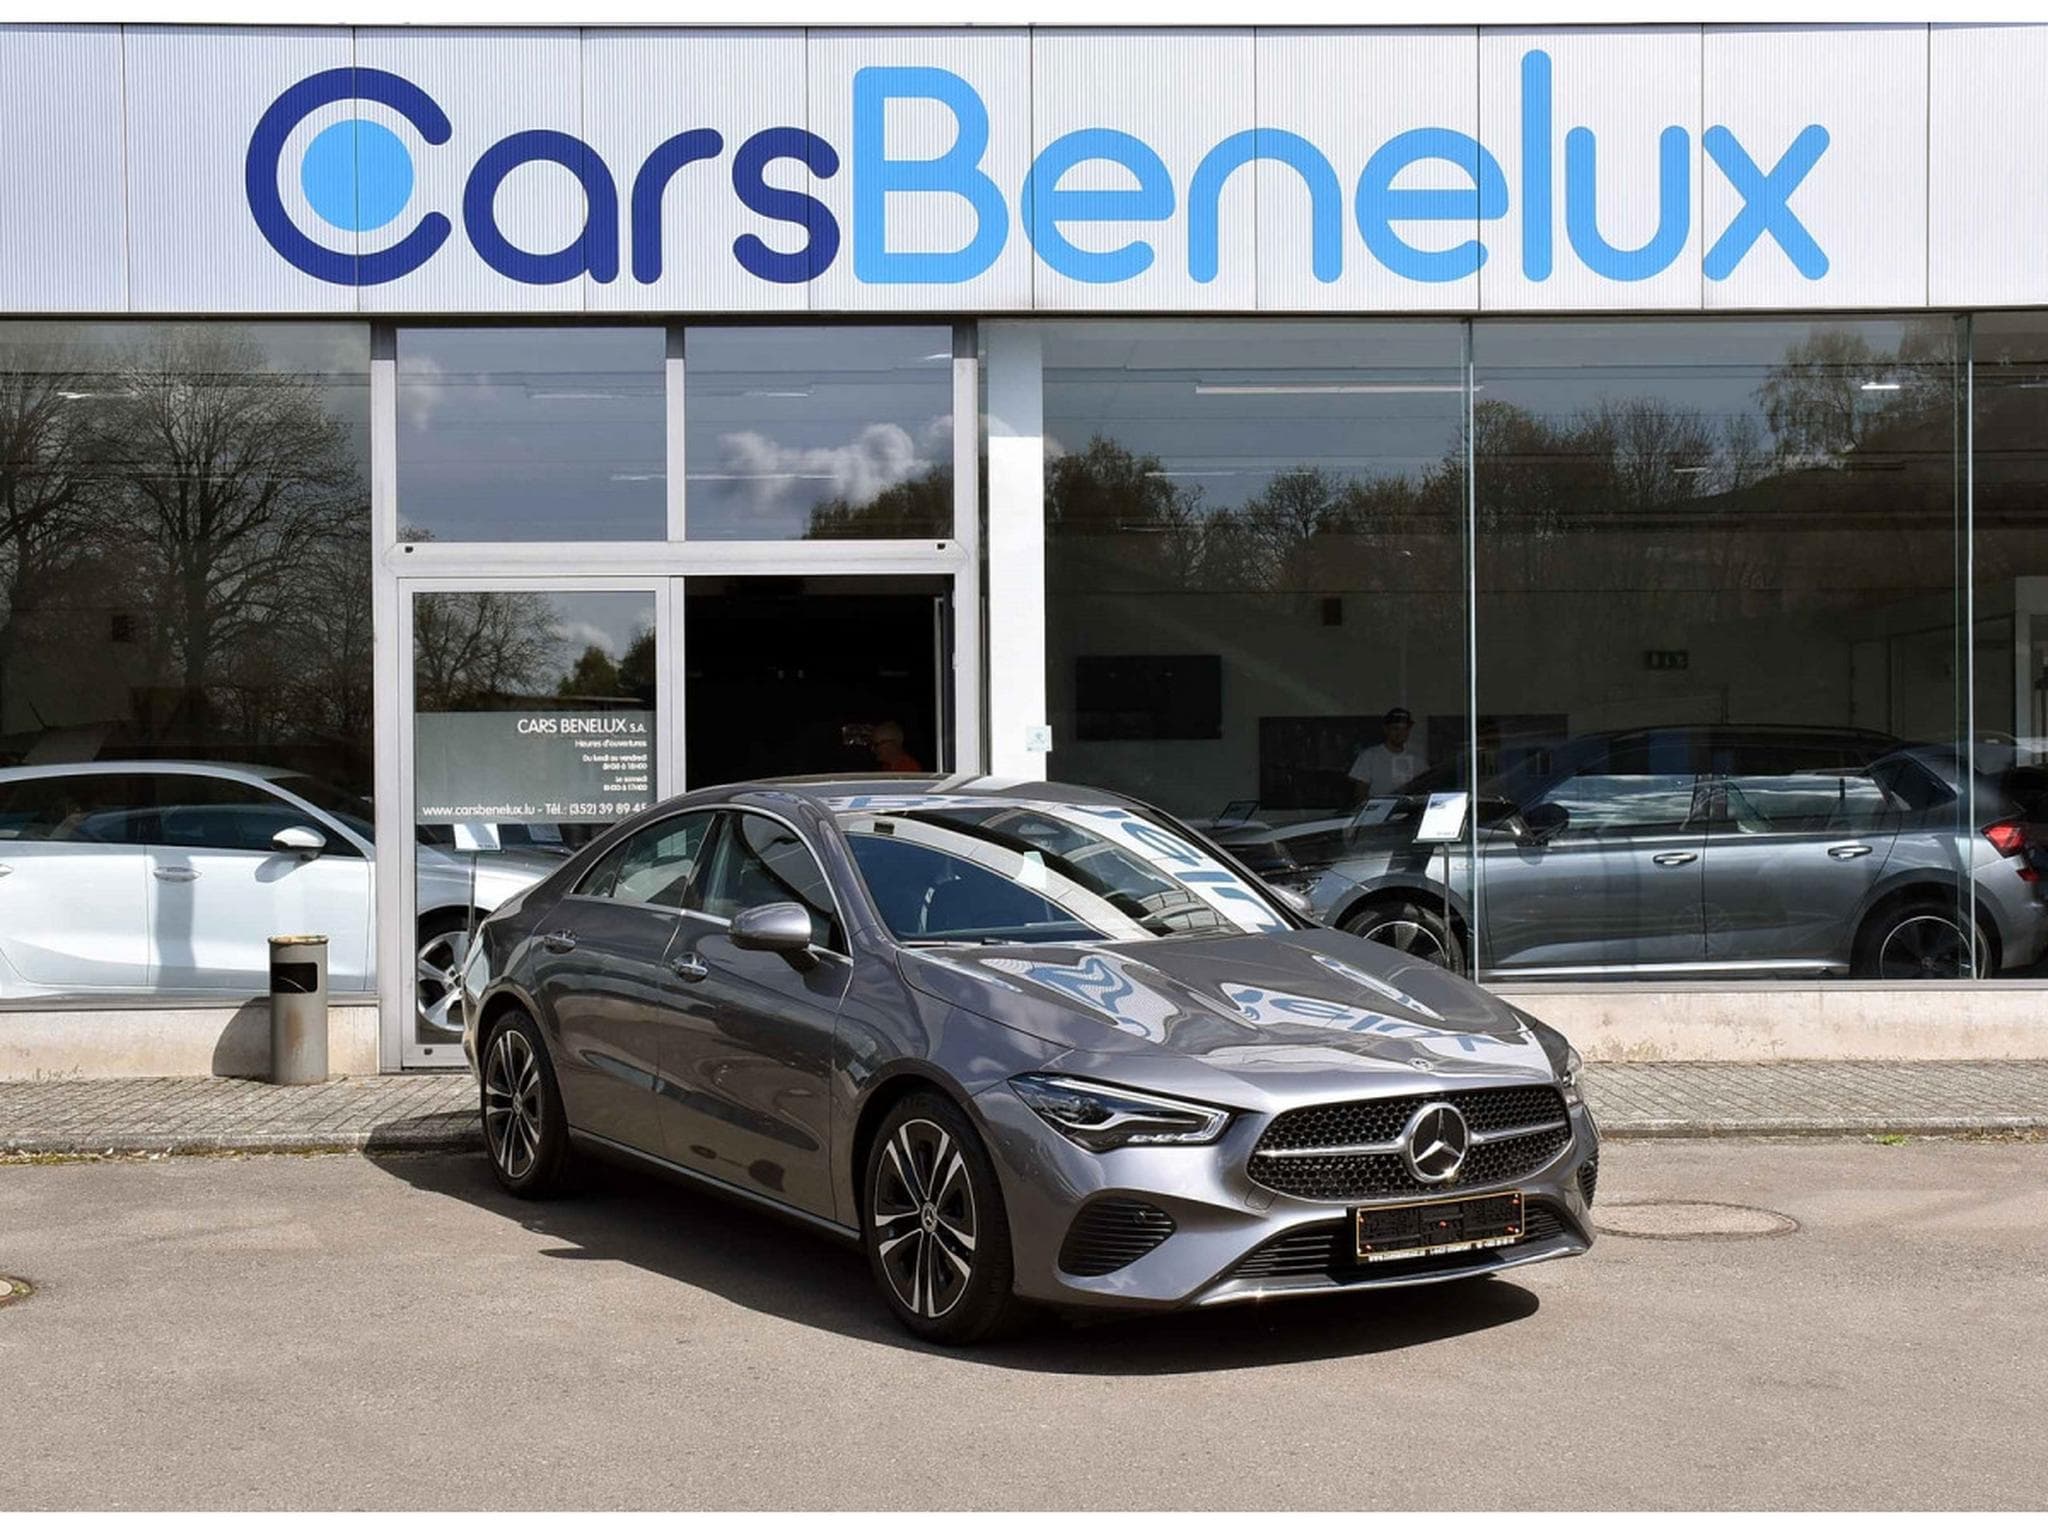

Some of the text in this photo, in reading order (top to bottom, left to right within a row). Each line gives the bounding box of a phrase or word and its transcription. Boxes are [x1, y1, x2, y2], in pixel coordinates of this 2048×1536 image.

[517, 718, 557, 734] CARS
[560, 718, 628, 734] BENELUX
[422, 802, 536, 816] www.carsbenelux.lu
[569, 802, 597, 816] (352)
[599, 802, 614, 815] 39
[616, 802, 631, 815] 89
